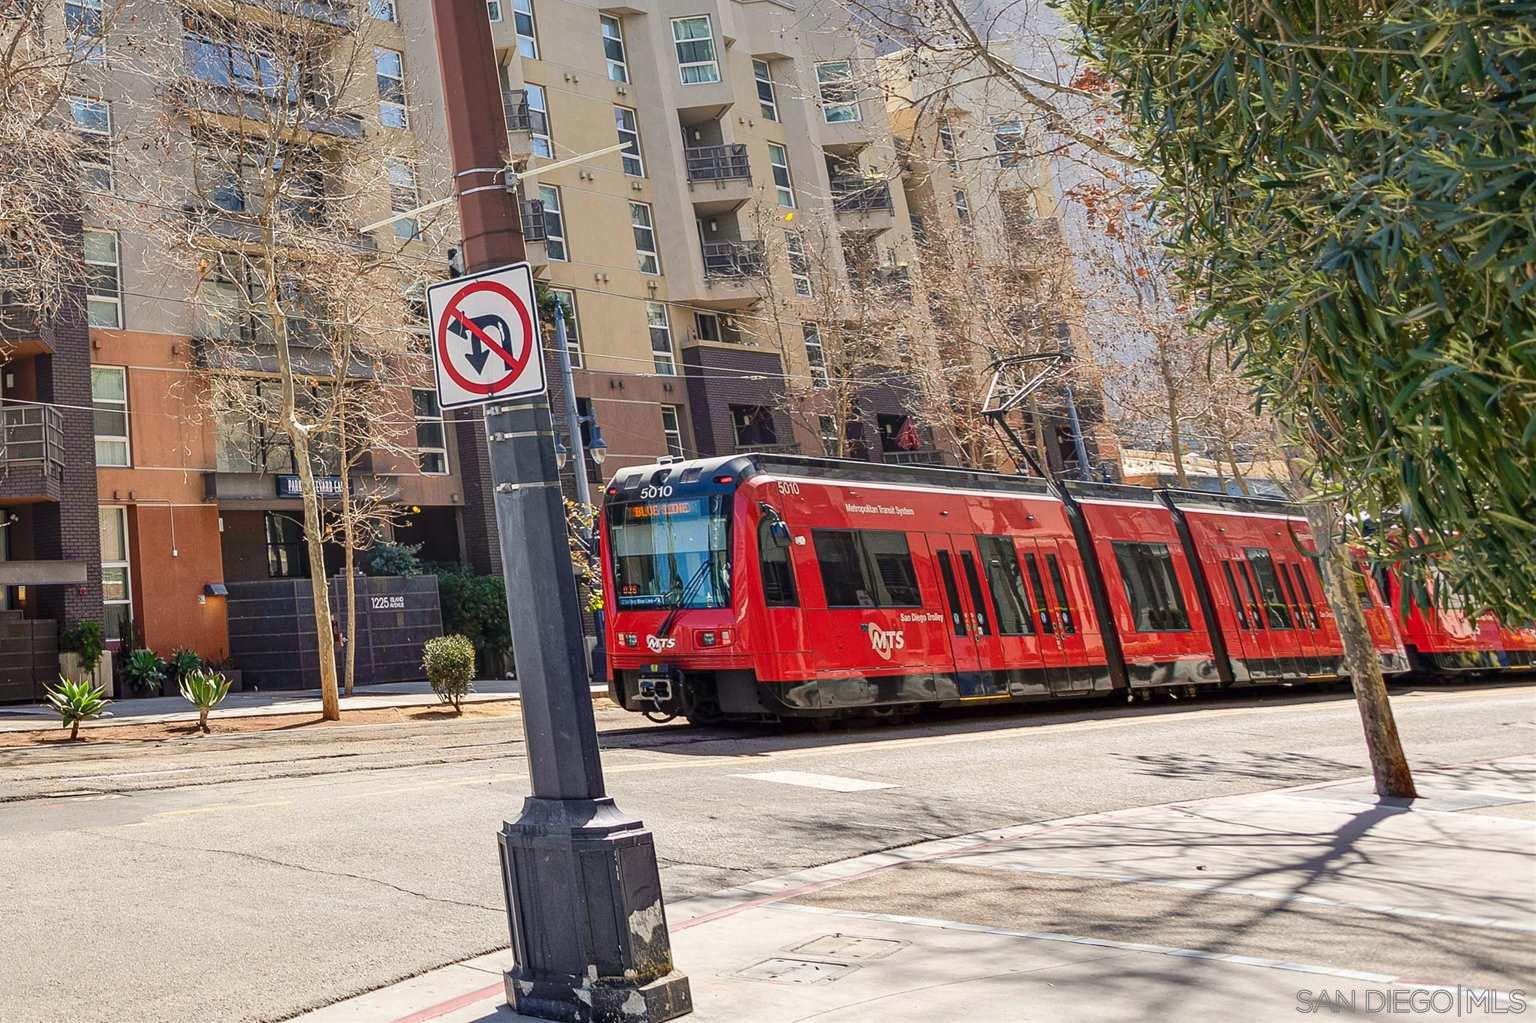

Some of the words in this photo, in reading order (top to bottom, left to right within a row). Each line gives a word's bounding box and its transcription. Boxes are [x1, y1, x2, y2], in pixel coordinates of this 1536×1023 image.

[640, 484, 673, 499] 5010
[778, 481, 800, 495] 5010
[844, 503, 878, 514] Metropolitan
[877, 504, 895, 515] Transit
[895, 505, 914, 516] System
[371, 596, 389, 609] 1225
[900, 612, 911, 622] San
[911, 612, 926, 624] Diego
[926, 612, 943, 623] Trolley
[647, 637, 676, 649] MTS
[872, 630, 904, 650] MTS
